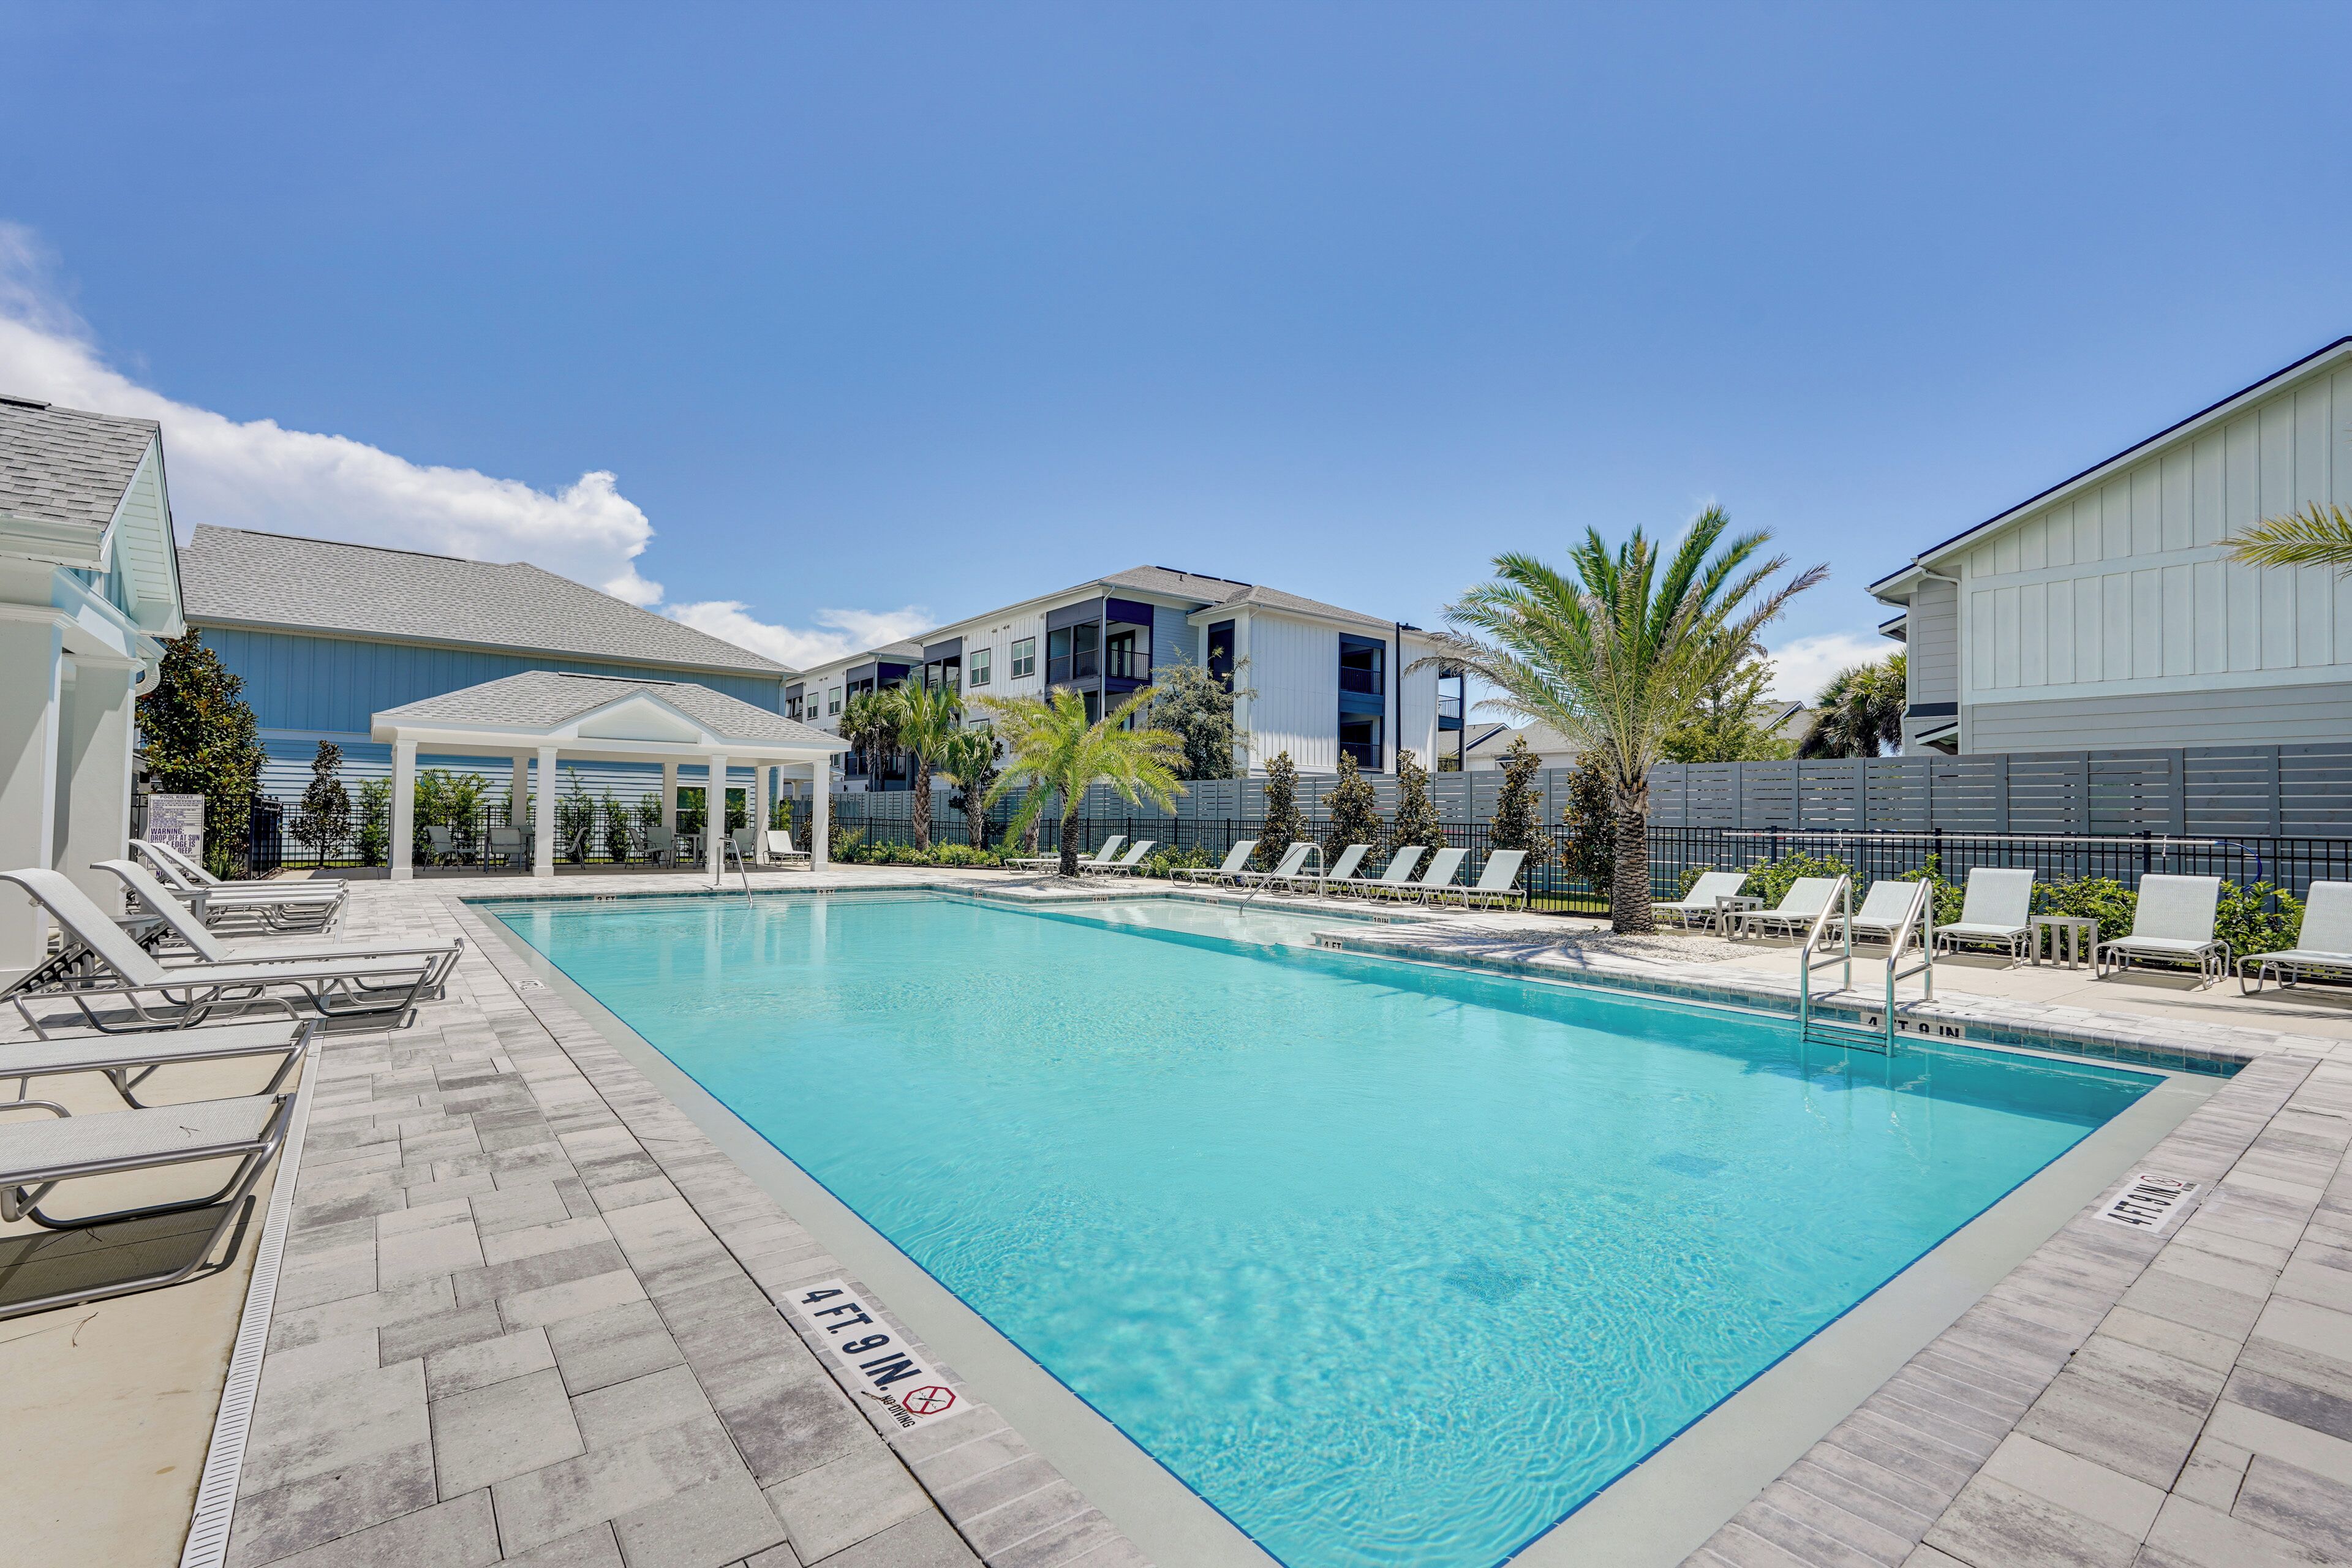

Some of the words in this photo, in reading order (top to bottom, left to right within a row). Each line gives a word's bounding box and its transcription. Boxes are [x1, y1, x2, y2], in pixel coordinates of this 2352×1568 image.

[1939, 1025, 1959, 1038] IN
[2127, 1194, 2171, 1206] 9
[2107, 1213, 2152, 1225] 4
[801, 1289, 844, 1305] 4
[813, 1302, 874, 1334] FT.
[842, 1334, 890, 1354] 9
[859, 1352, 922, 1391] IN.
[881, 1394, 896, 1405] NO
[888, 1404, 915, 1428] DIVING
